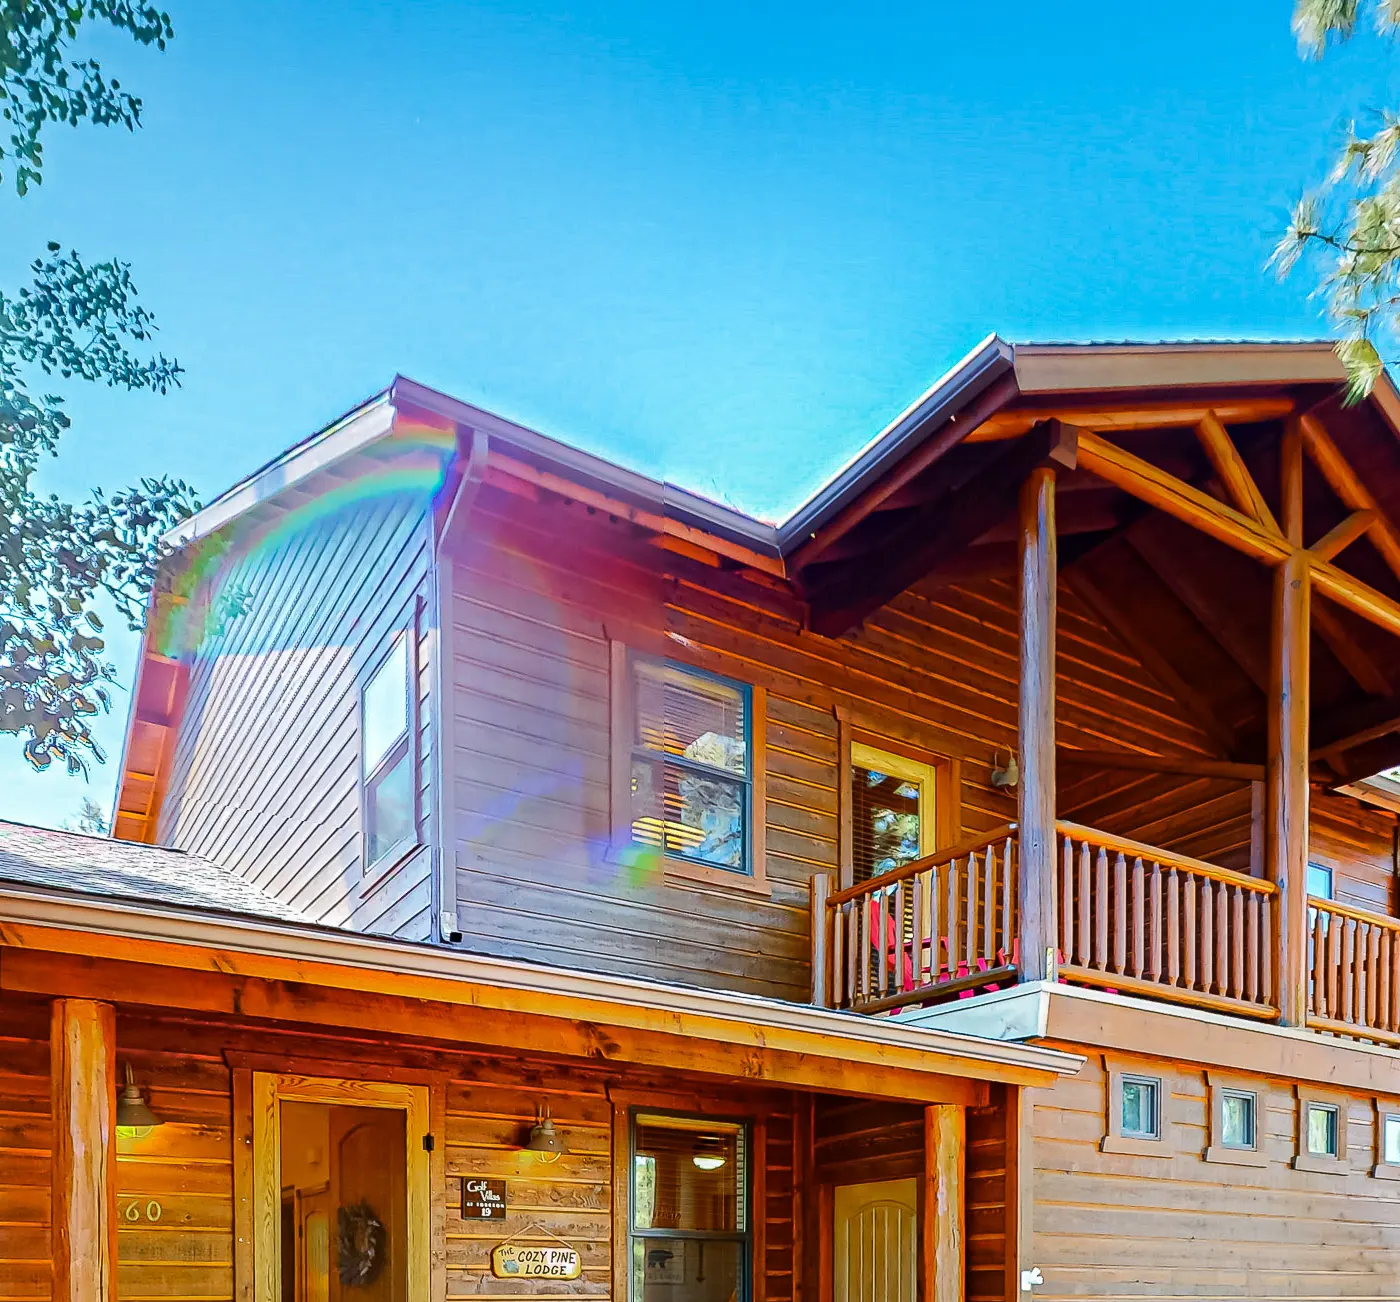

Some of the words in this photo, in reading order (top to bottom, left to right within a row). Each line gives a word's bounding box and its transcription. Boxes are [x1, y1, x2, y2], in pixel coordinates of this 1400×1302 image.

[467, 1181, 487, 1192] Golf
[480, 1190, 500, 1201] Villas
[117, 1200, 161, 1222] 60
[481, 1207, 491, 1217] 19
[498, 1247, 514, 1257] THE
[517, 1250, 547, 1263] COZY
[550, 1251, 576, 1264] PINE
[525, 1264, 567, 1276] LODGE
